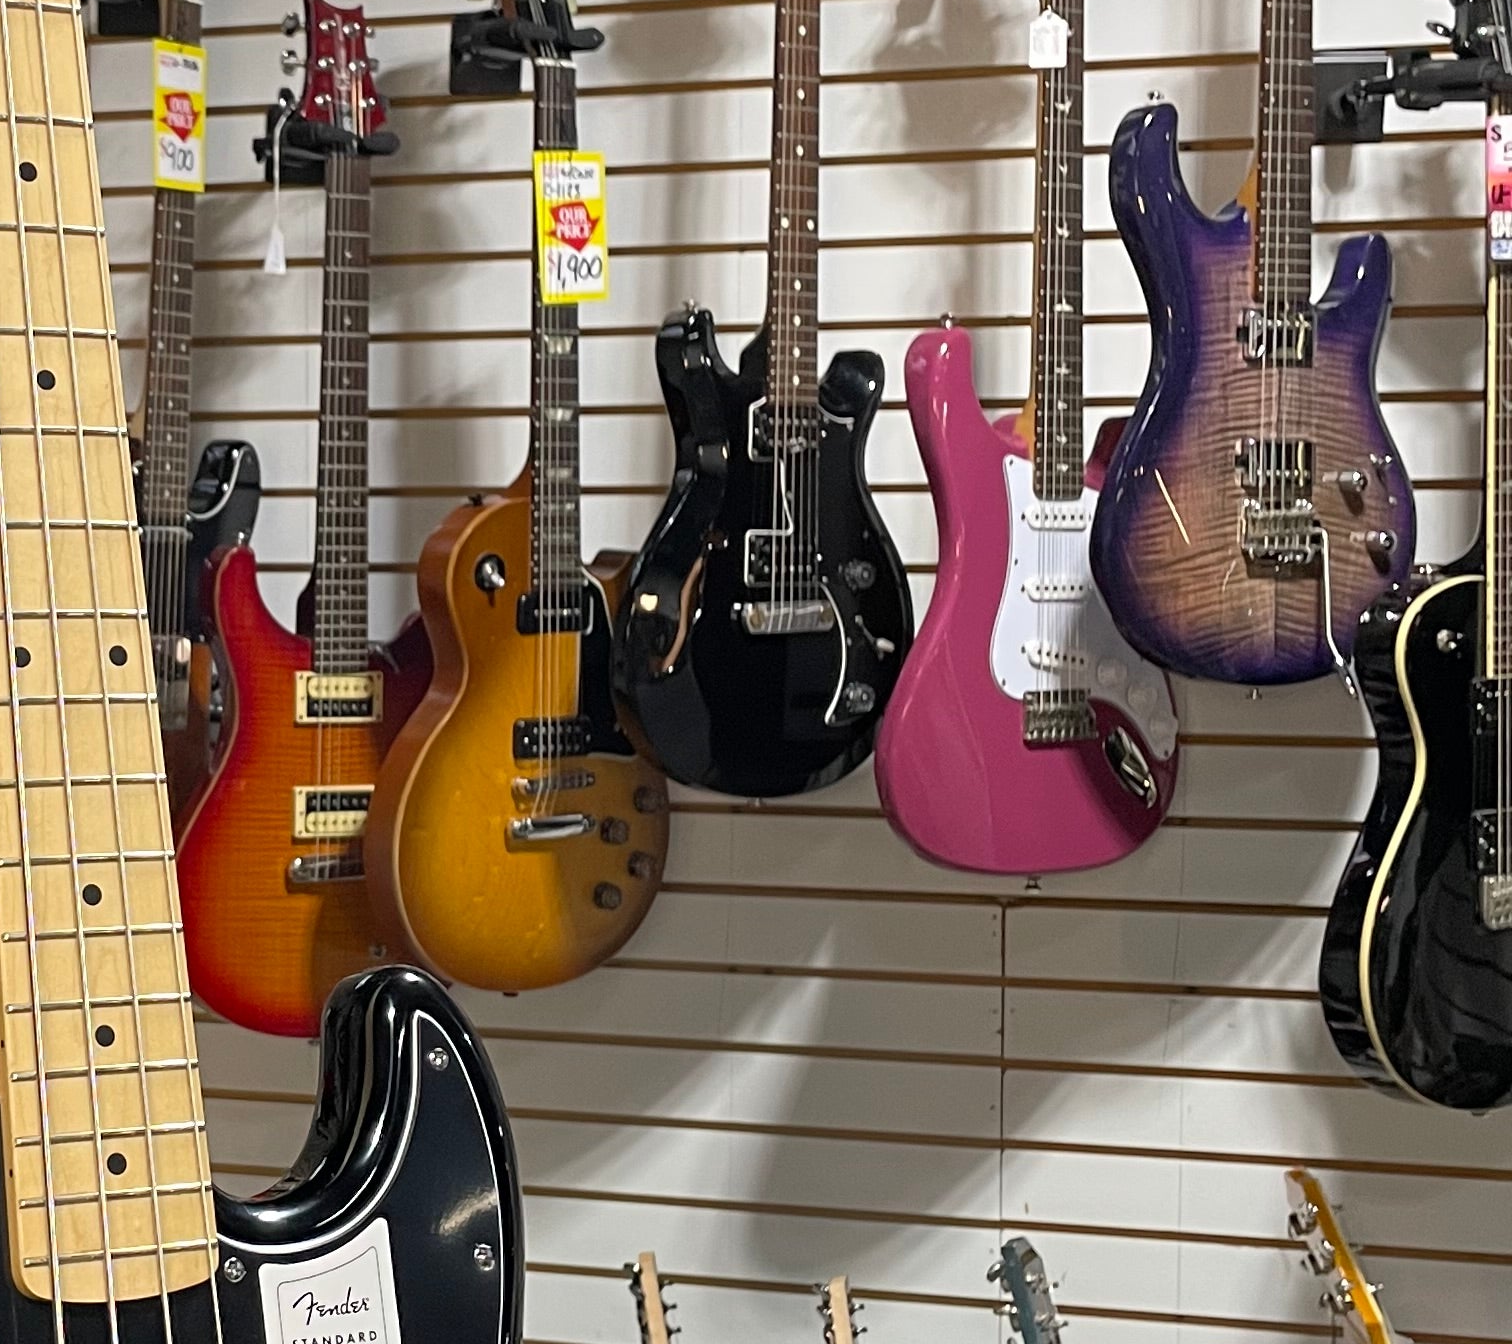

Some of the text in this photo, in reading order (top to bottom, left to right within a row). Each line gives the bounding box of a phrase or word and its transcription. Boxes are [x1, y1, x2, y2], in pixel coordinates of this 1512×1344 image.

[169, 95, 193, 114] OUR
[557, 206, 588, 224] OUR
[556, 222, 592, 240] PRICE
[292, 1285, 371, 1326] Fender
